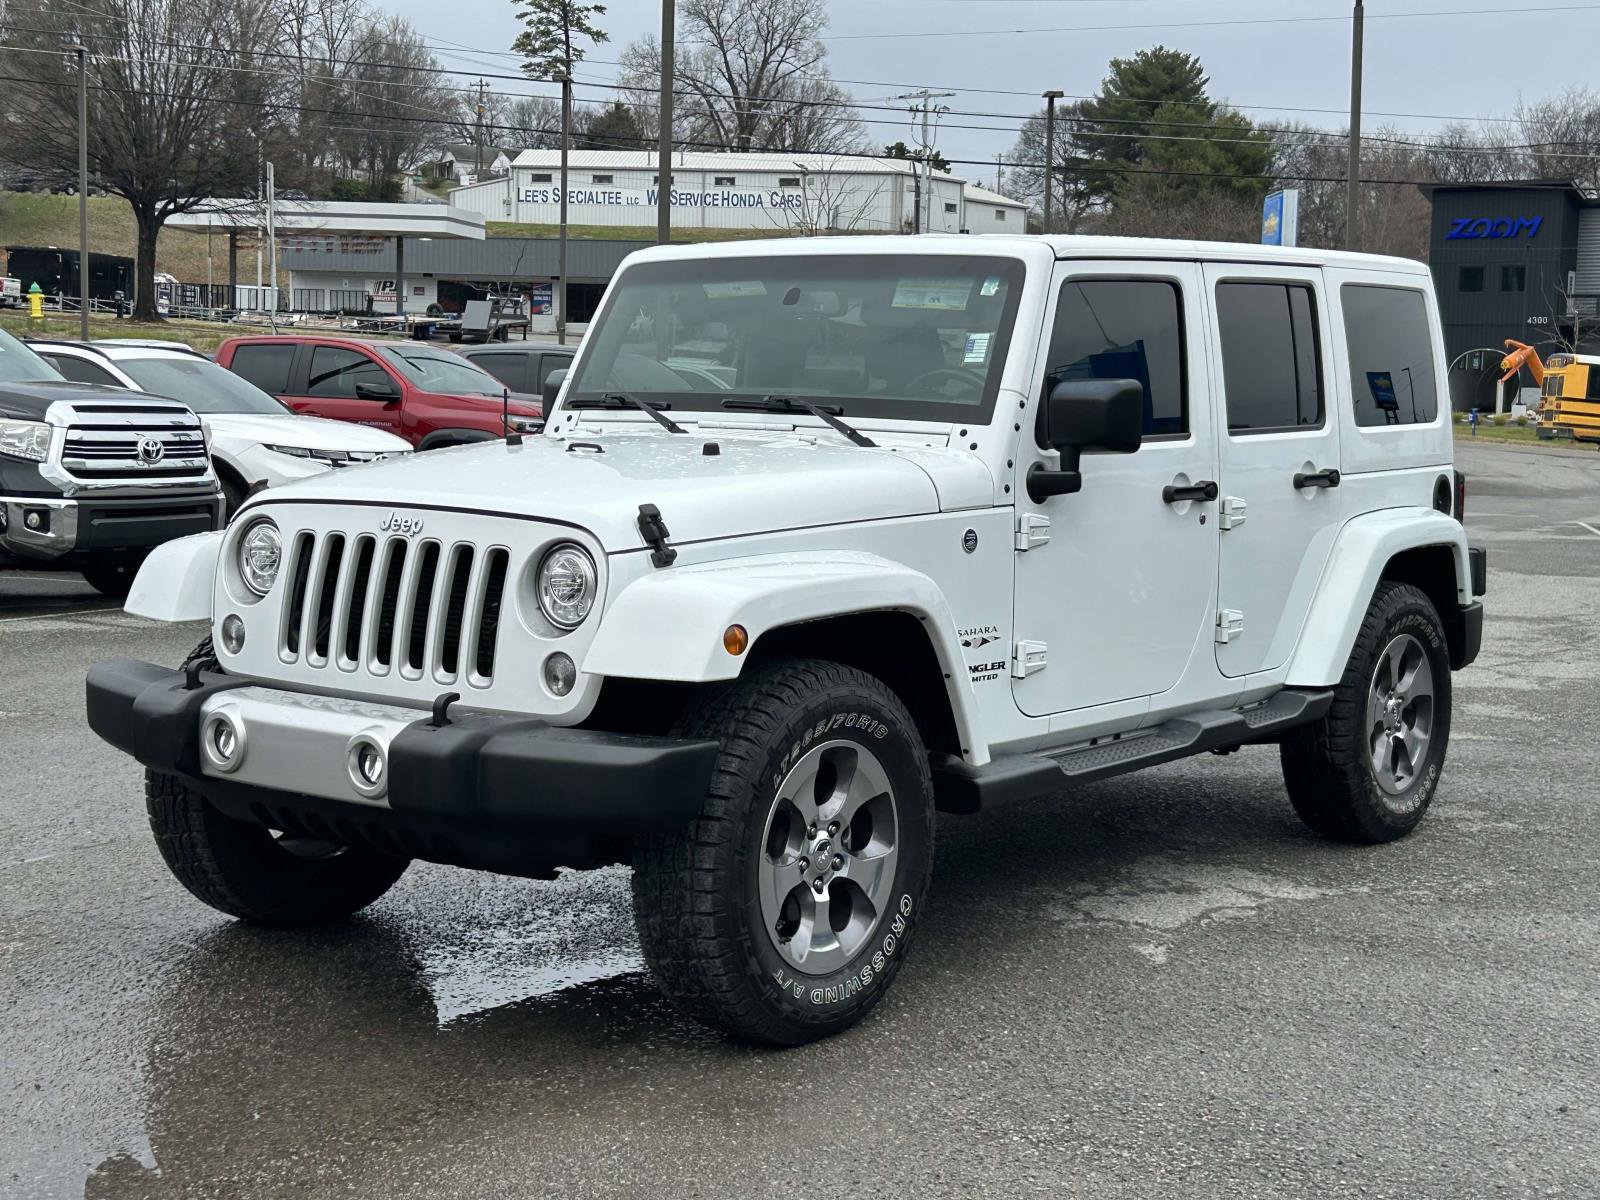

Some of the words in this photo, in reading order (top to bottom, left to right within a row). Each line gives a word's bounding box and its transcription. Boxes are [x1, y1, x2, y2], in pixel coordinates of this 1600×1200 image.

[517, 187, 549, 203] LEE'S
[552, 187, 622, 205] SECIALTEE
[626, 196, 640, 205] LLC
[669, 189, 719, 207] SERVICE
[721, 190, 763, 208] HONDA
[770, 191, 802, 208] CARS
[1446, 215, 1545, 240] ZOOM
[1527, 316, 1548, 325] 4300
[380, 511, 424, 537] Jeep
[957, 625, 998, 638] SAHARA
[968, 660, 1006, 675] NGLER
[810, 894, 913, 1005] CROSSWIND
[773, 969, 806, 999] A/T
